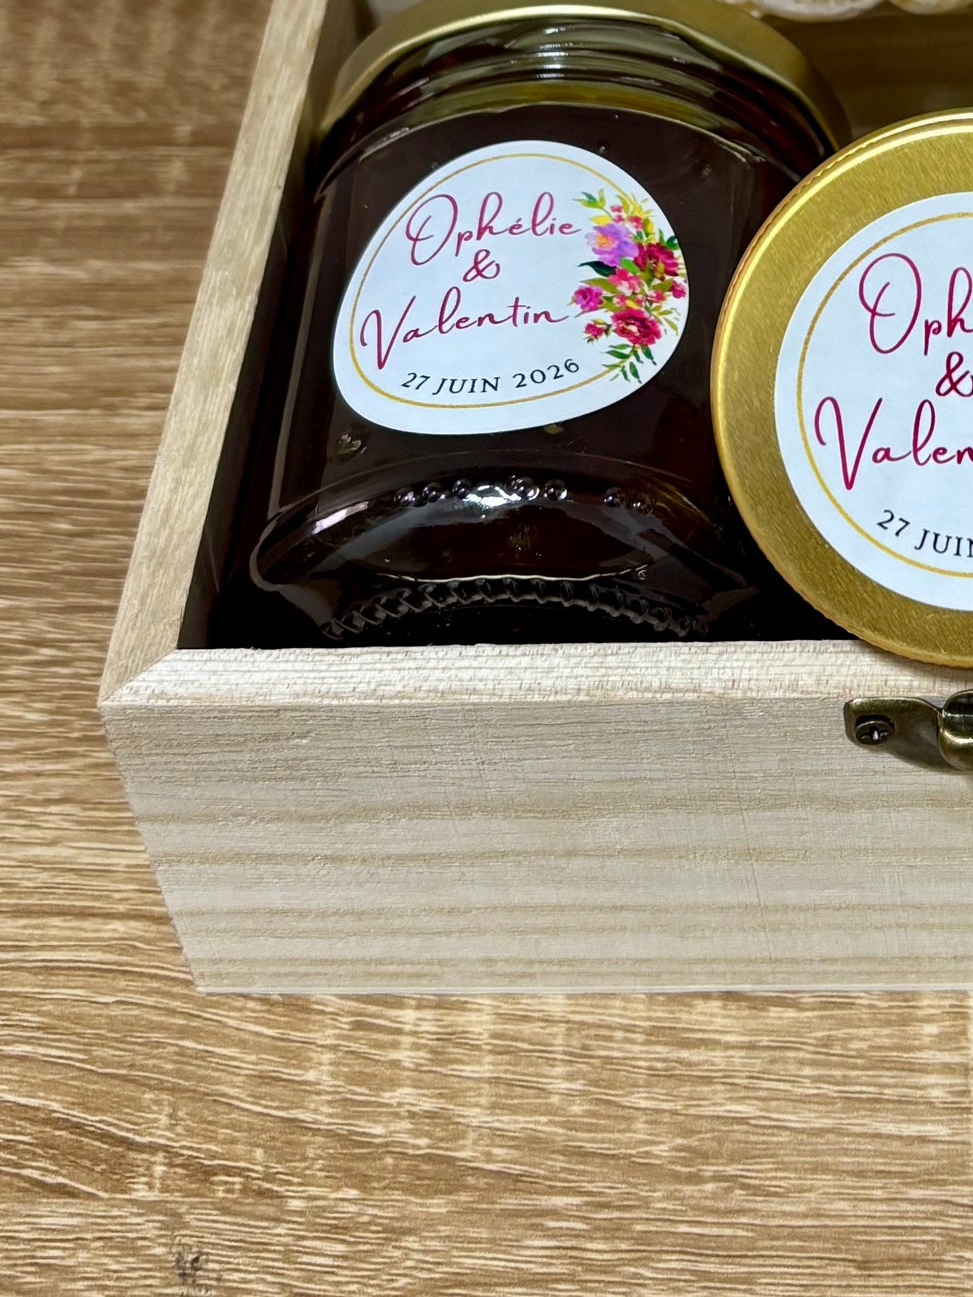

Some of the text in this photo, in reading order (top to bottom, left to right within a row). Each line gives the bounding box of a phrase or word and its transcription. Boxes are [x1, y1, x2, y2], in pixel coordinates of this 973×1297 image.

[405, 192, 582, 265] Ophélie
[463, 249, 500, 282] &
[360, 286, 570, 370] Valentin
[401, 358, 579, 395] 27 JUIN 2026
[877, 509, 910, 537] 27
